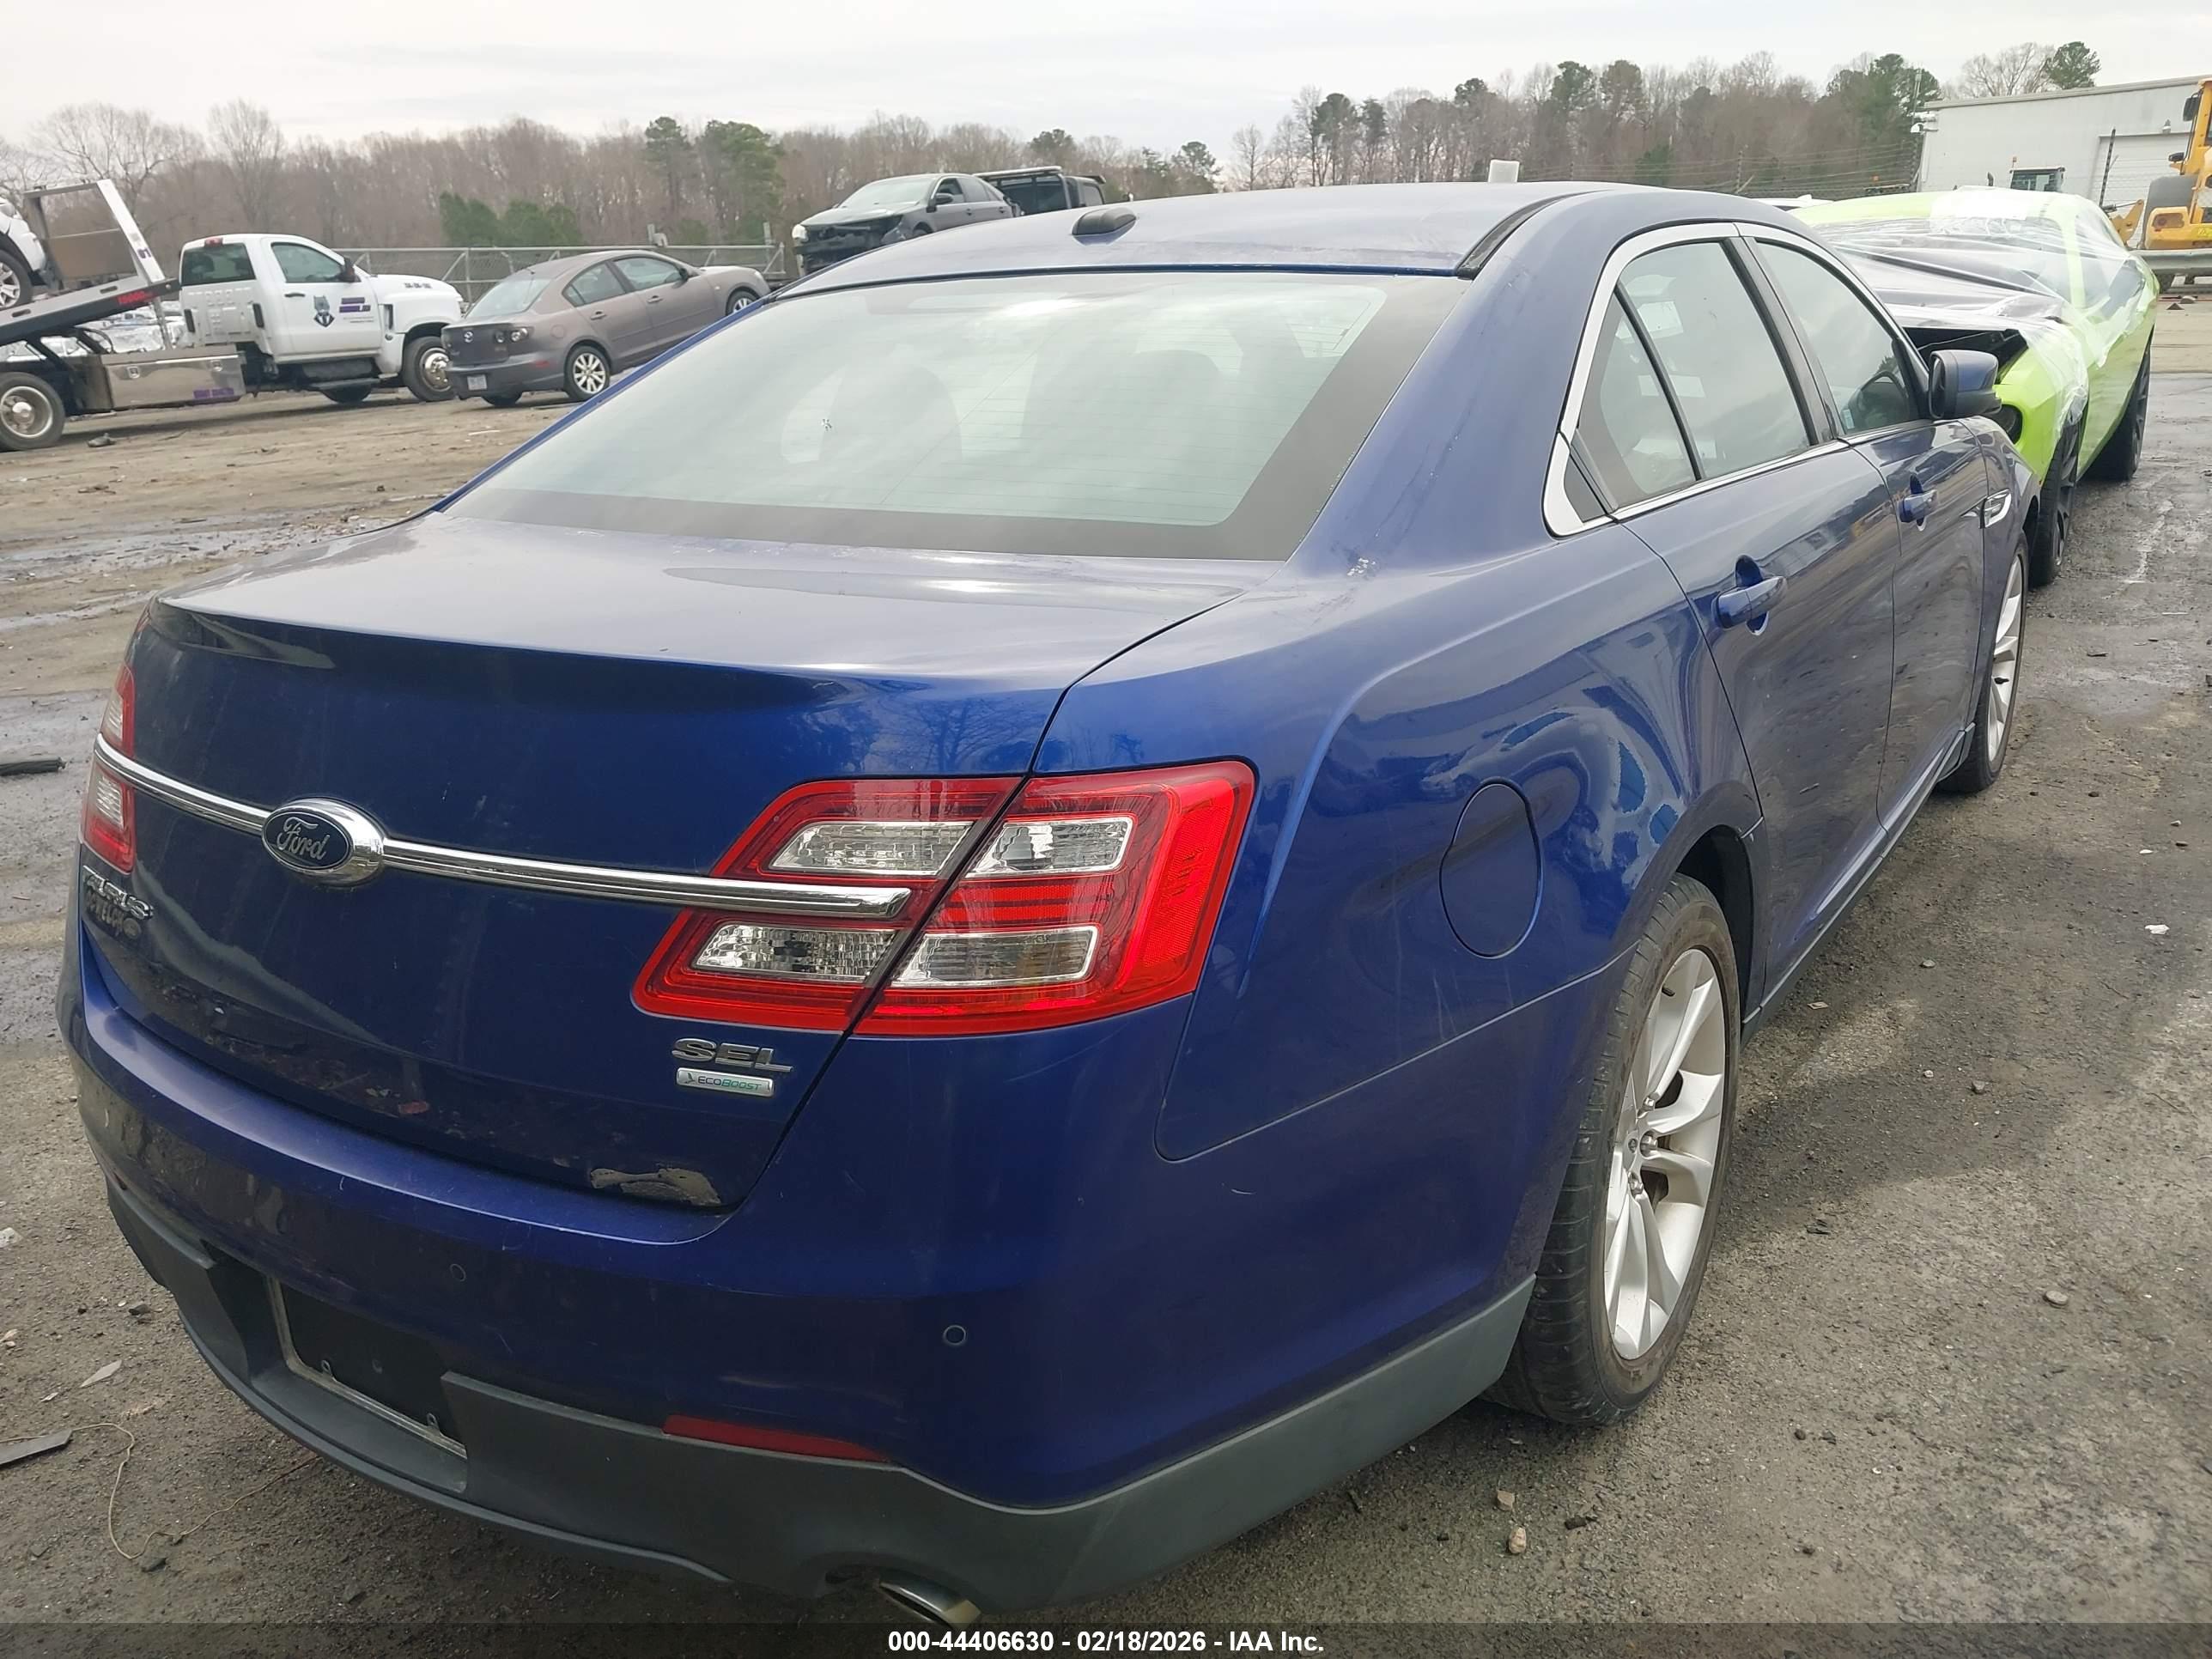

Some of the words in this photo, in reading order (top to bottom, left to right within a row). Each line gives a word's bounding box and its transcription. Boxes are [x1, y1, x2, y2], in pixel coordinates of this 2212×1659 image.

[276, 816, 331, 860] Ford
[83, 865, 155, 921] TAURUS
[672, 1037, 794, 1073] SEL
